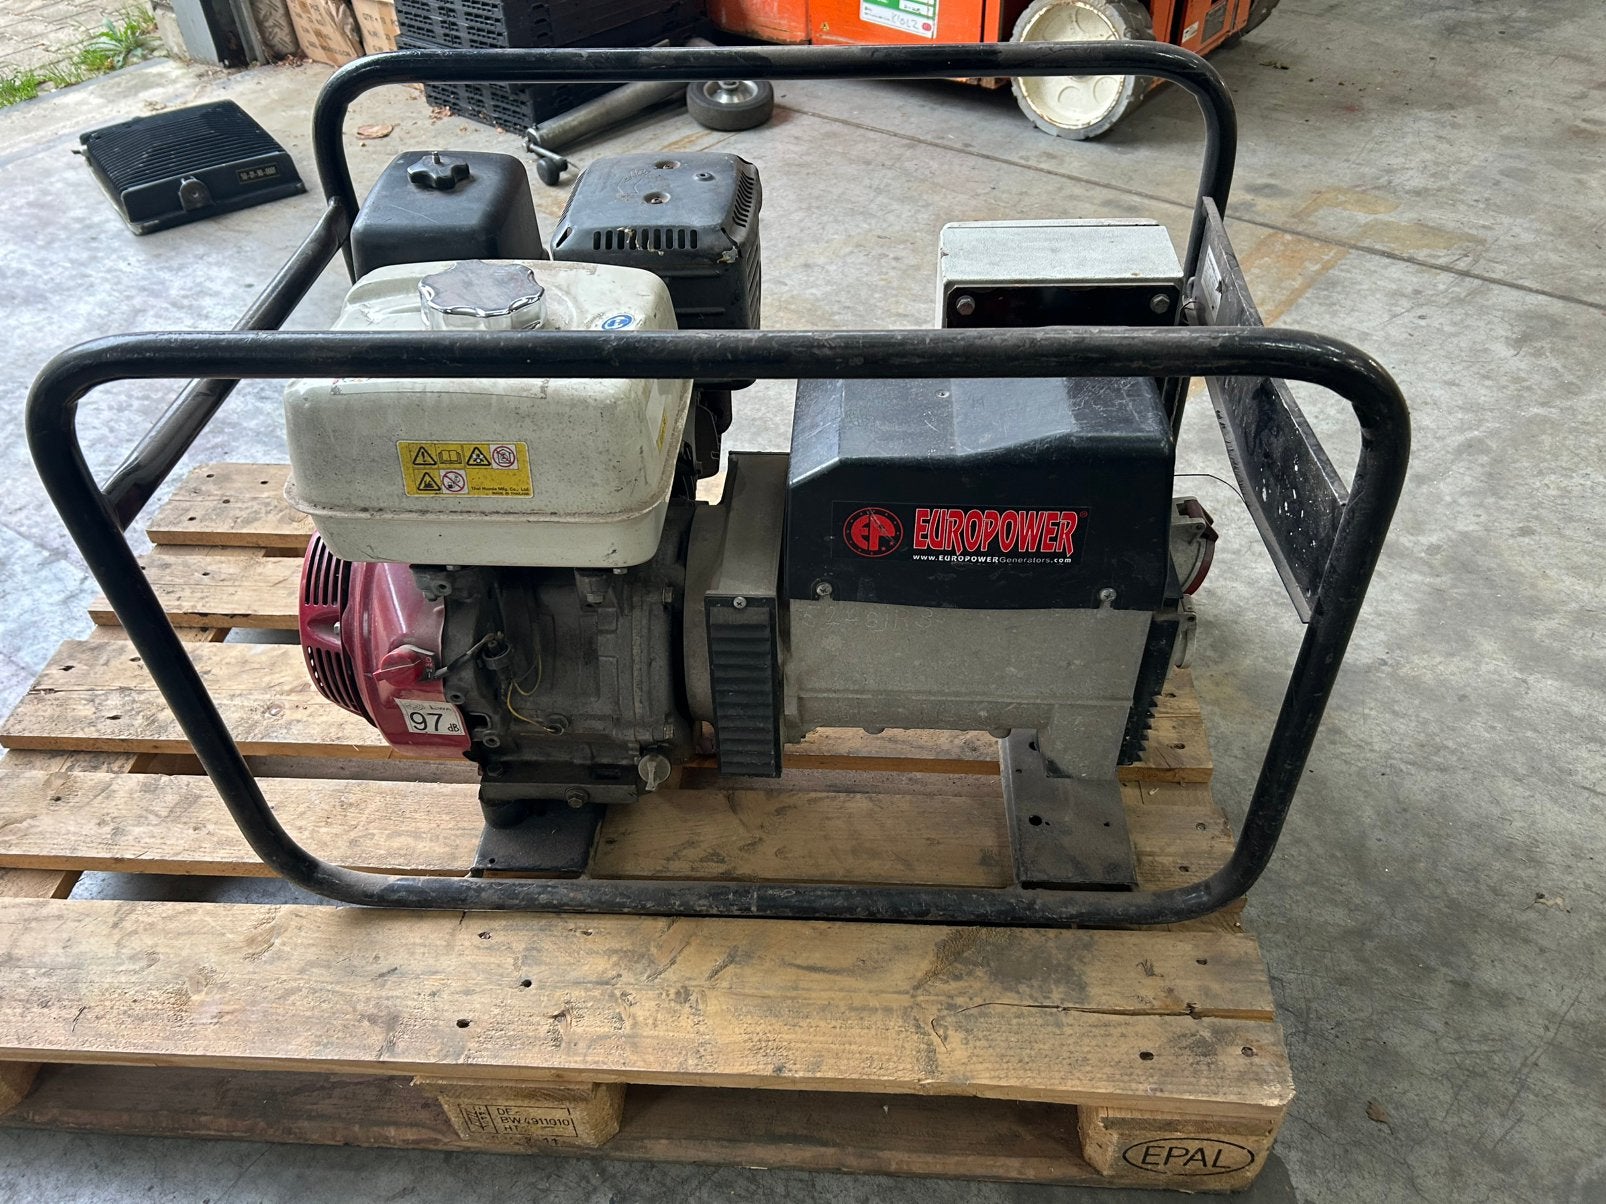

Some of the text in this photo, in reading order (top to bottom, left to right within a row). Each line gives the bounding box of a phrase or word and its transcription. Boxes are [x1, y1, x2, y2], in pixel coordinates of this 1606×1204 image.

[913, 508, 1078, 557] EUROPOWER
[912, 554, 1072, 564] www.EUROPOWERGenerators.com
[410, 712, 460, 732] 97 dB
[1141, 1145, 1231, 1169] EPAL
